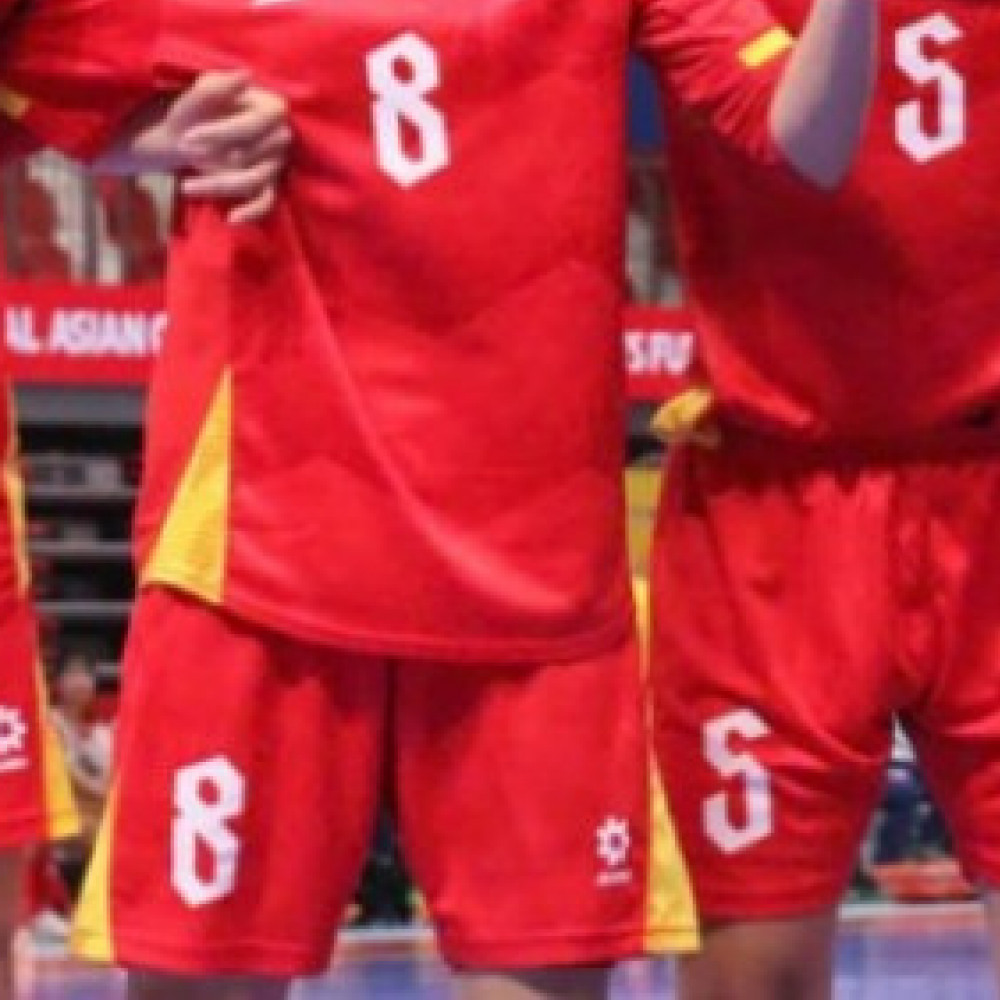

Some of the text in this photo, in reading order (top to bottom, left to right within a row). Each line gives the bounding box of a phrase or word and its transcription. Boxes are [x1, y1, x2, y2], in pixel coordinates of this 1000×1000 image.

[366, 34, 448, 186] 8
[893, 16, 963, 161] 5
[171, 757, 244, 906] 8
[703, 711, 771, 853] 5
